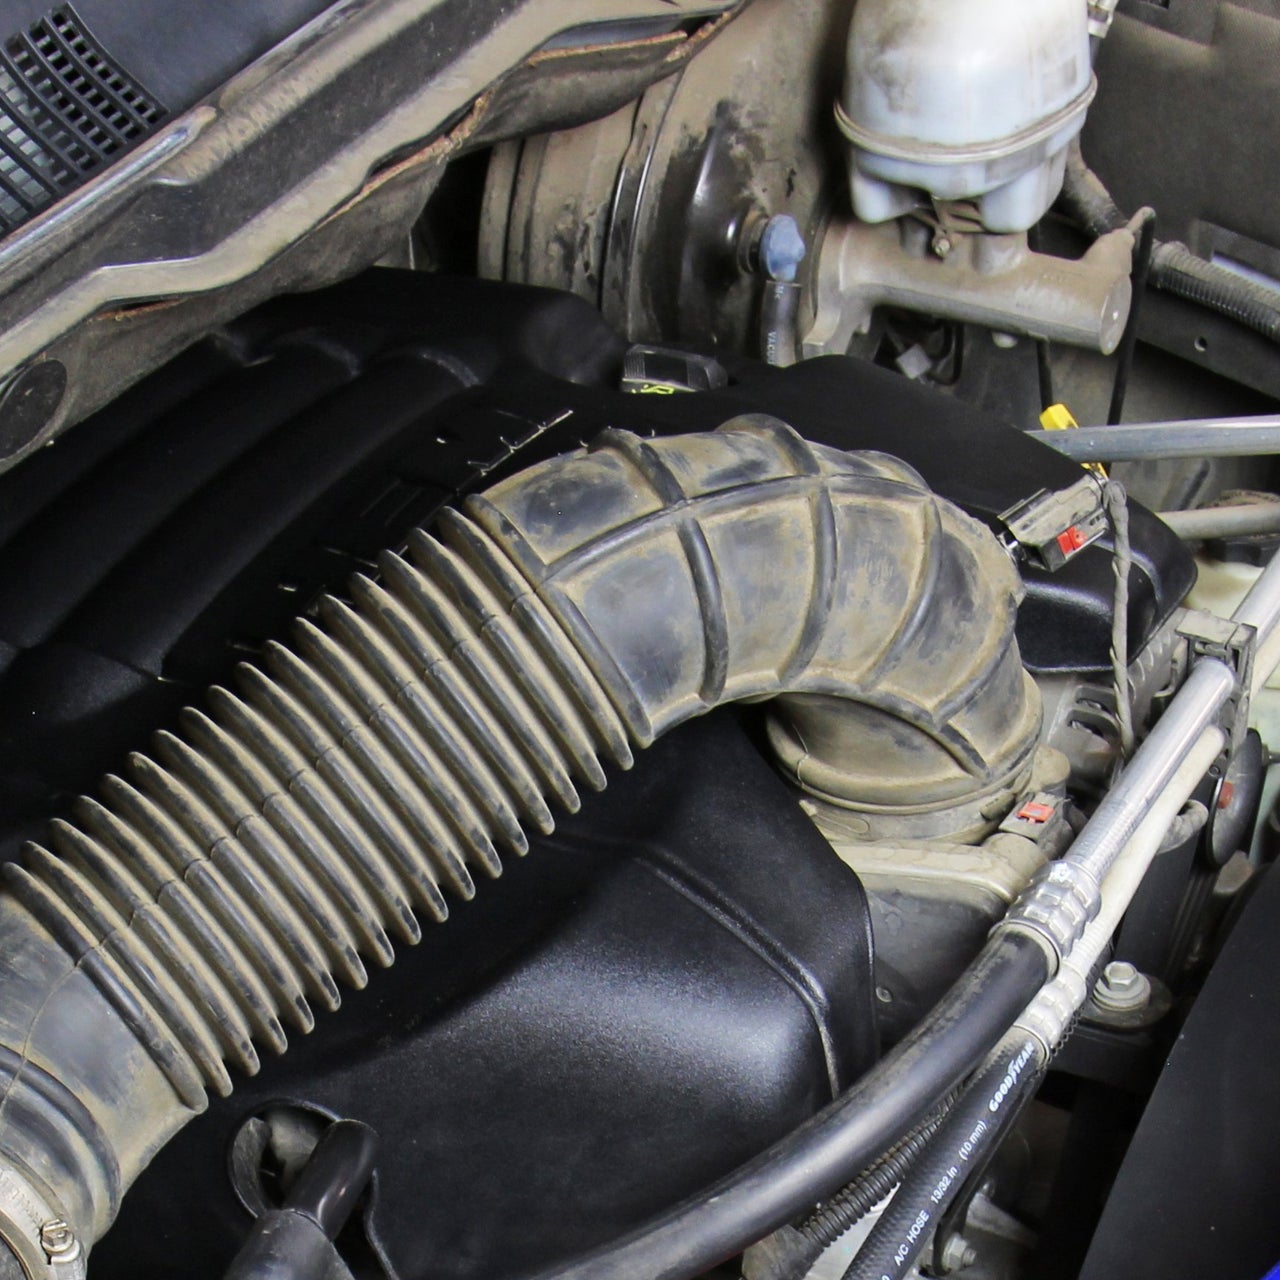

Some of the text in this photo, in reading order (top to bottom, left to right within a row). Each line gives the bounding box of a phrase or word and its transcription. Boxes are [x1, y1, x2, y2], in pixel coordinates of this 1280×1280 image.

[894, 1243, 909, 1267] A/C
[906, 1209, 930, 1245] HOSE
[930, 1175, 952, 1204] 13/32
[958, 1141, 973, 1161] (10
[969, 1120, 987, 1145] mm)
[988, 1041, 1035, 1112] GOODYEAR
